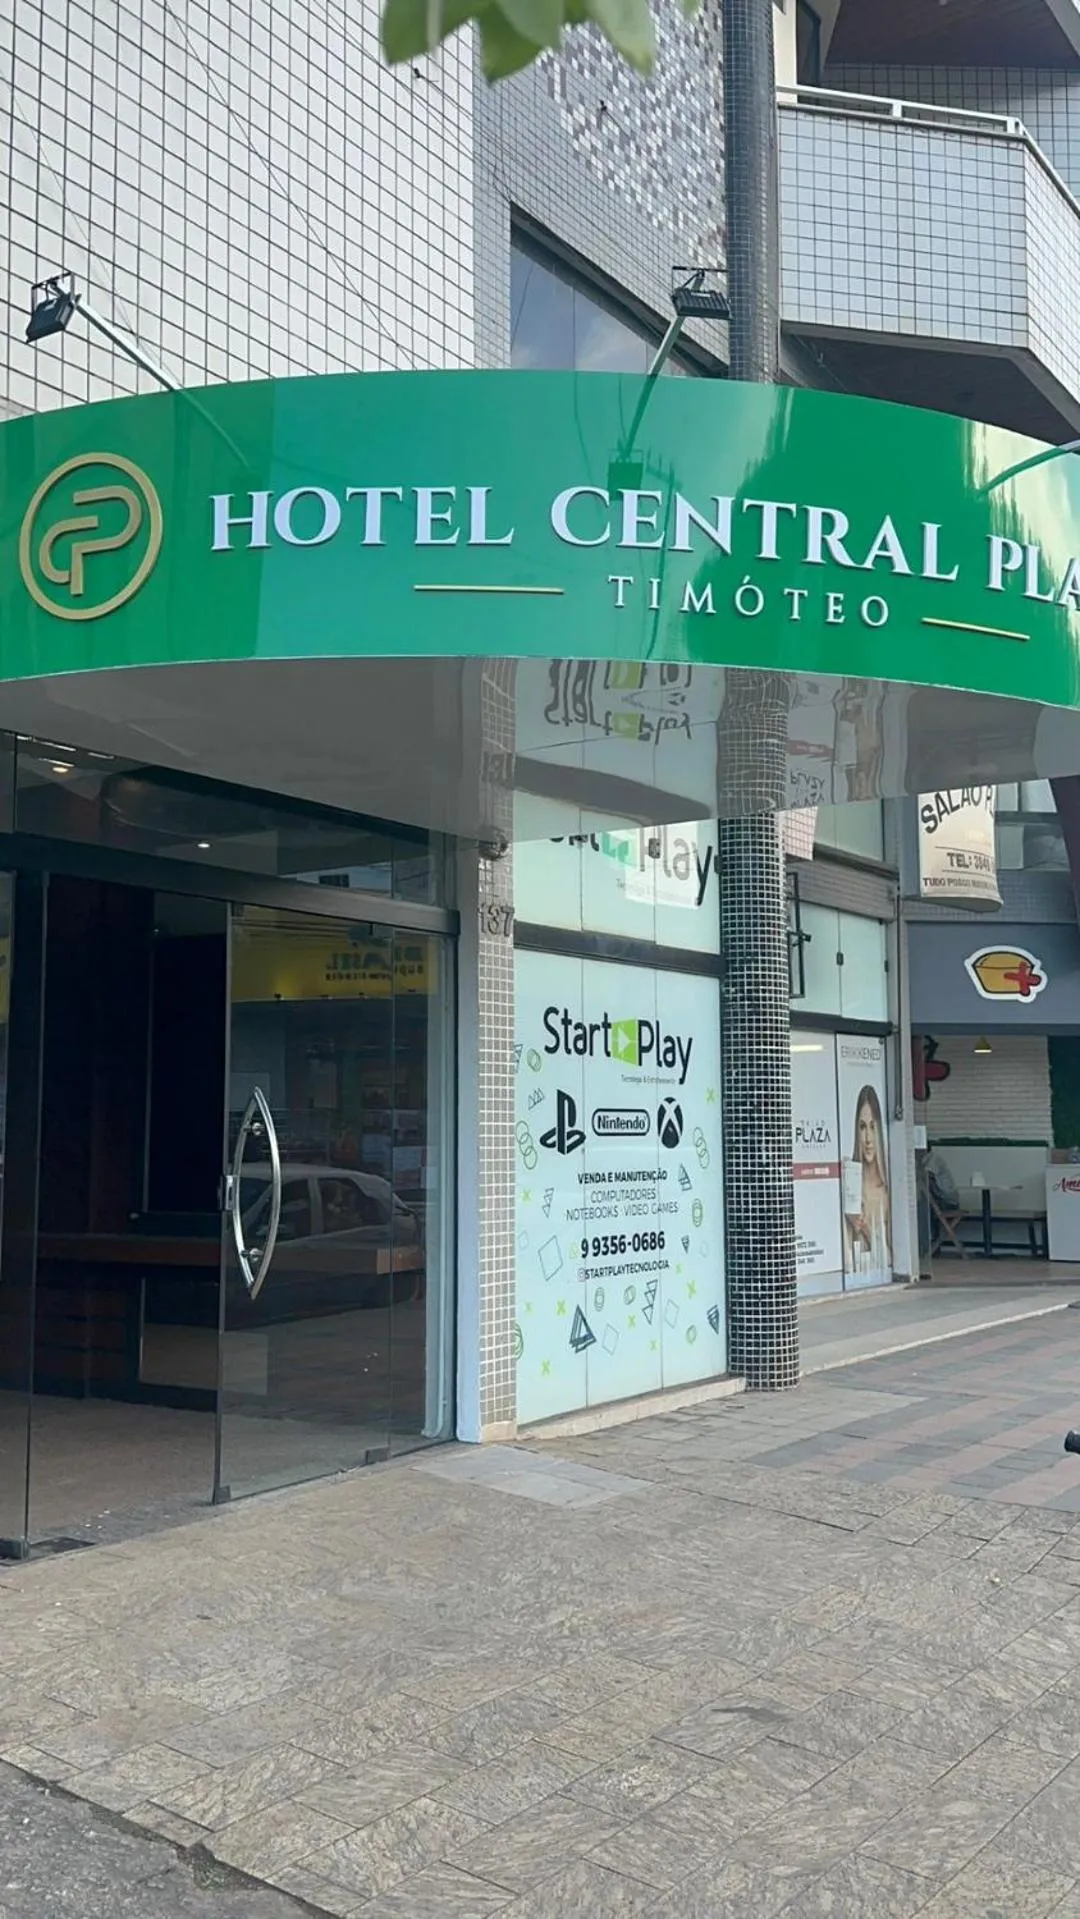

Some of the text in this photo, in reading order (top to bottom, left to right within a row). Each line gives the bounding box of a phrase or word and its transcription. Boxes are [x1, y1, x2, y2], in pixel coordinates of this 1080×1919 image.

[210, 486, 515, 551] HOTEL
[549, 485, 960, 582] CENTRAL
[607, 574, 890, 628] TIMÓTEO
[946, 852, 973, 869] TEL:
[922, 877, 946, 887] TUDO
[543, 1006, 693, 1085] Start Play
[597, 1115, 646, 1129] Nintendo
[795, 1126, 831, 1143] PLAZA
[578, 1168, 668, 1184] VENDA E MANUTENÇÃO
[590, 1188, 657, 1204] COMPUTADORES
[566, 1201, 679, 1221] NOTEBOOKS VIDEO GAMES
[581, 1230, 665, 1258] 9 9356-0686
